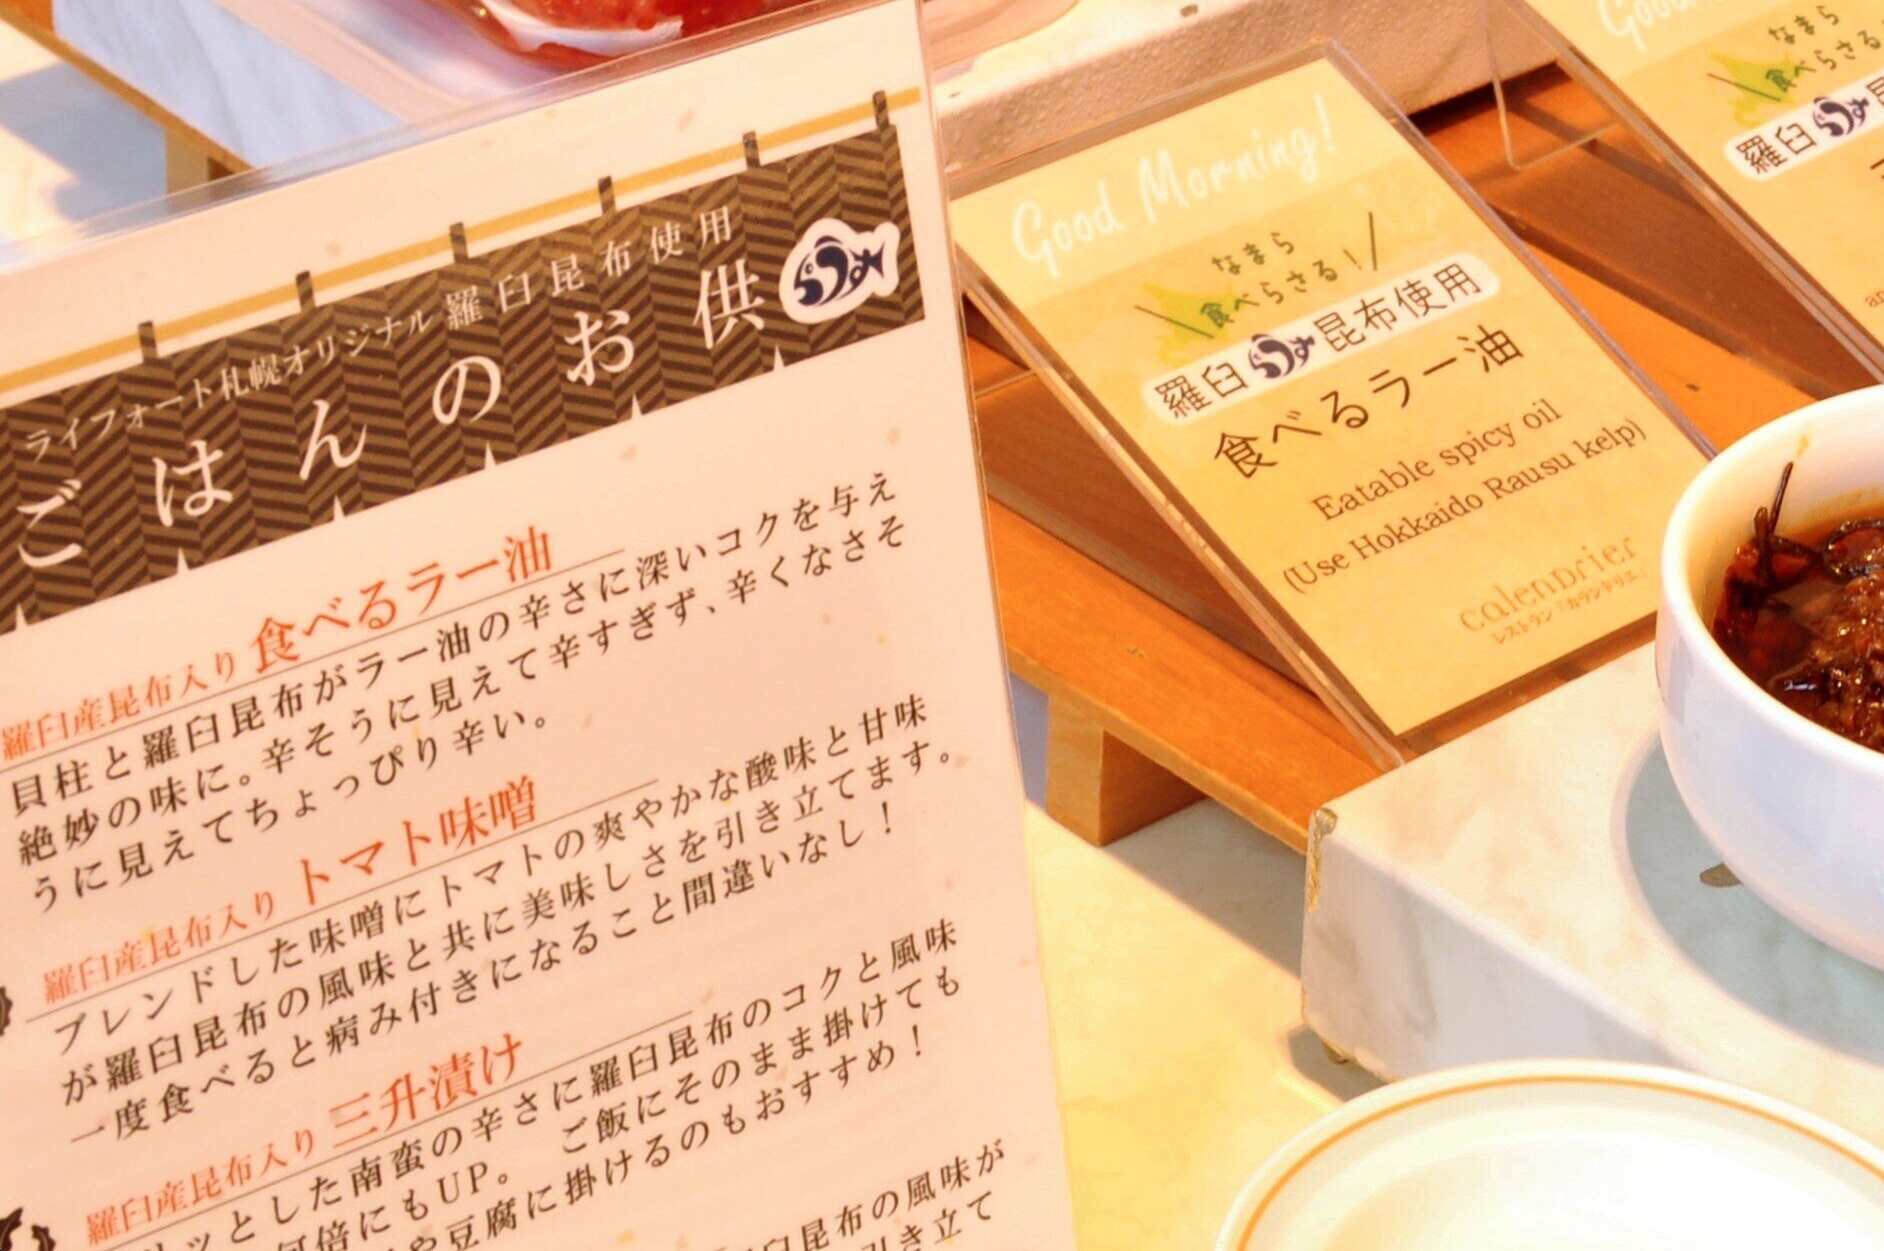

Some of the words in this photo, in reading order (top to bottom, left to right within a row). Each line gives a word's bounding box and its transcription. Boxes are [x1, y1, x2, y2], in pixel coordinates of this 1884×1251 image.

[1767, 6, 1840, 46] なまら
[1011, 186, 1123, 281] Good
[1137, 93, 1338, 223] Morning!
[1736, 120, 1815, 177] 羅臼
[1210, 231, 1296, 273] なまら
[26, 309, 433, 463] ライフォート札幌オリジナル
[445, 205, 732, 330] 羅臼昆布使用
[1155, 358, 1250, 419] 羅臼
[1312, 262, 1484, 353] 昆布使用
[1212, 323, 1524, 480] 食べるラー油
[17, 258, 764, 568] ごはんのお供
[1310, 453, 1437, 522] Eatable
[1437, 423, 1517, 474] spicy
[1520, 398, 1563, 431] oil
[1283, 543, 1350, 594] (Use
[1348, 491, 1485, 559] Hokkaido
[1483, 452, 1574, 502] Rausu
[1572, 416, 1646, 472] kelp)
[250, 525, 552, 674] 食べるラー油
[300, 774, 536, 906] トマト味噌
[330, 1033, 523, 1147] 三升漬け
